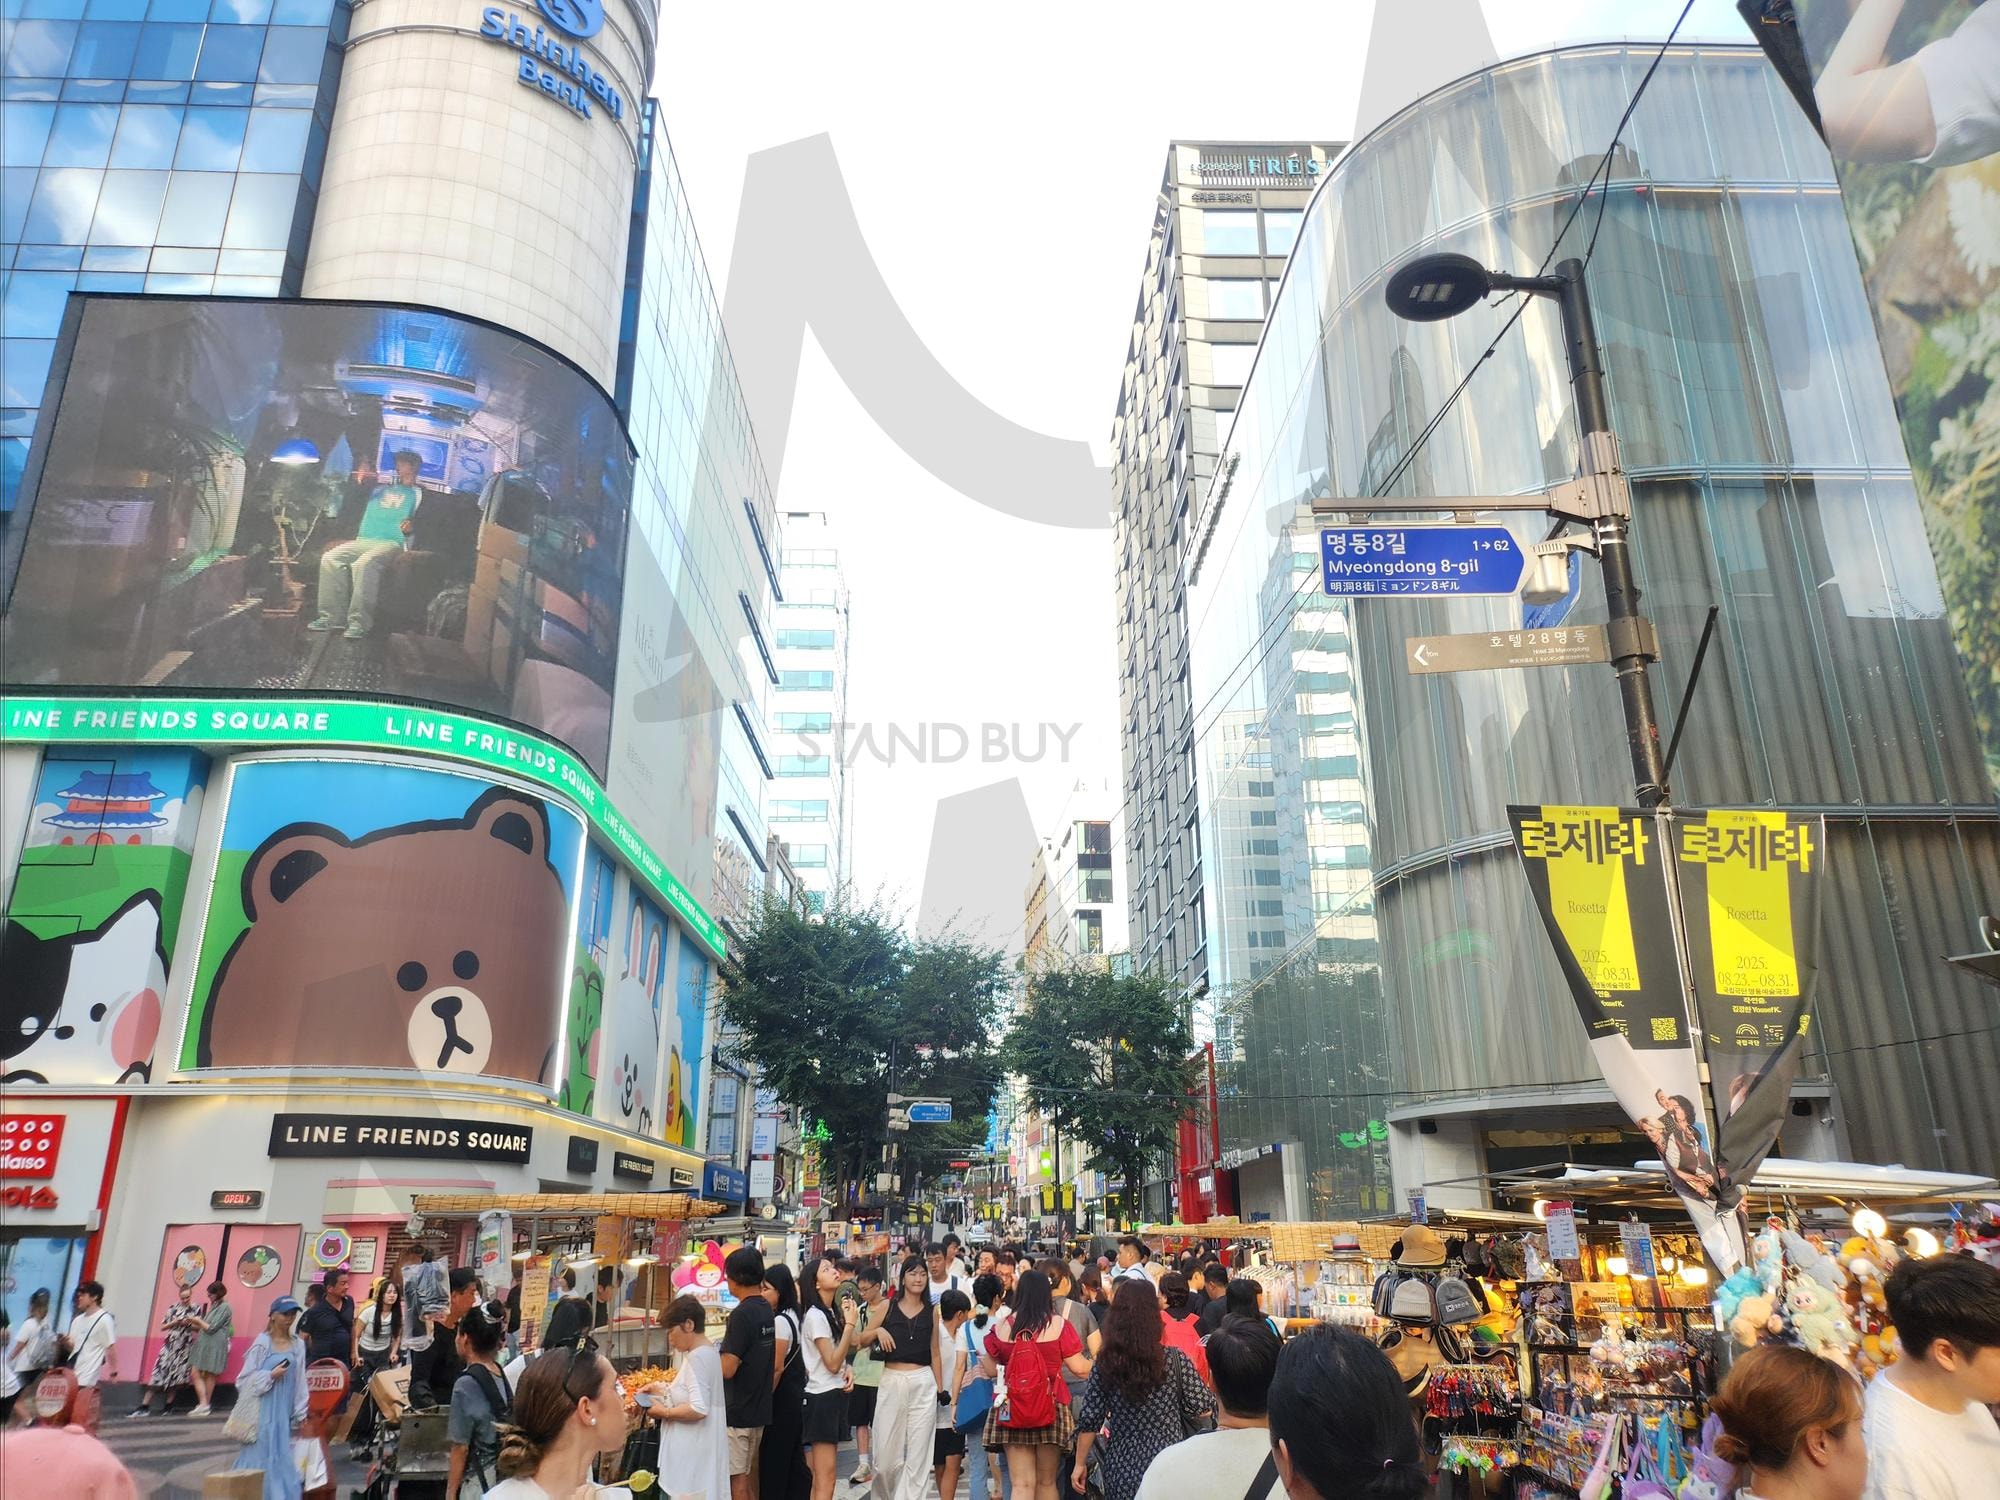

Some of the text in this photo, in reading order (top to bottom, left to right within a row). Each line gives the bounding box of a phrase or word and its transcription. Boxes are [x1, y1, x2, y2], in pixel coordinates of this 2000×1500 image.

[480, 7, 624, 120] Shinhan
[518, 54, 592, 120] Bank
[1327, 533, 1406, 555] 명동8길
[1473, 540, 1510, 551] 1 62
[1329, 559, 1479, 576] Myeongdong 8-gil
[73, 711, 198, 728] FRIENDS
[211, 712, 330, 731] SQUARE
[386, 717, 454, 742] LINE
[465, 730, 557, 773] FRIENDS
[561, 763, 596, 805] SQUARE
[604, 806, 662, 880] LINE FRIENDS SQUARE
[1568, 900, 1607, 914] Rosetta
[1727, 907, 1768, 921] Rosetta
[1581, 949, 1610, 963] 2025.
[1736, 956, 1768, 969] 2025.
[285, 1126, 528, 1152] LINE FRIENDS SQUARE
[224, 1193, 244, 1204] OPEN
